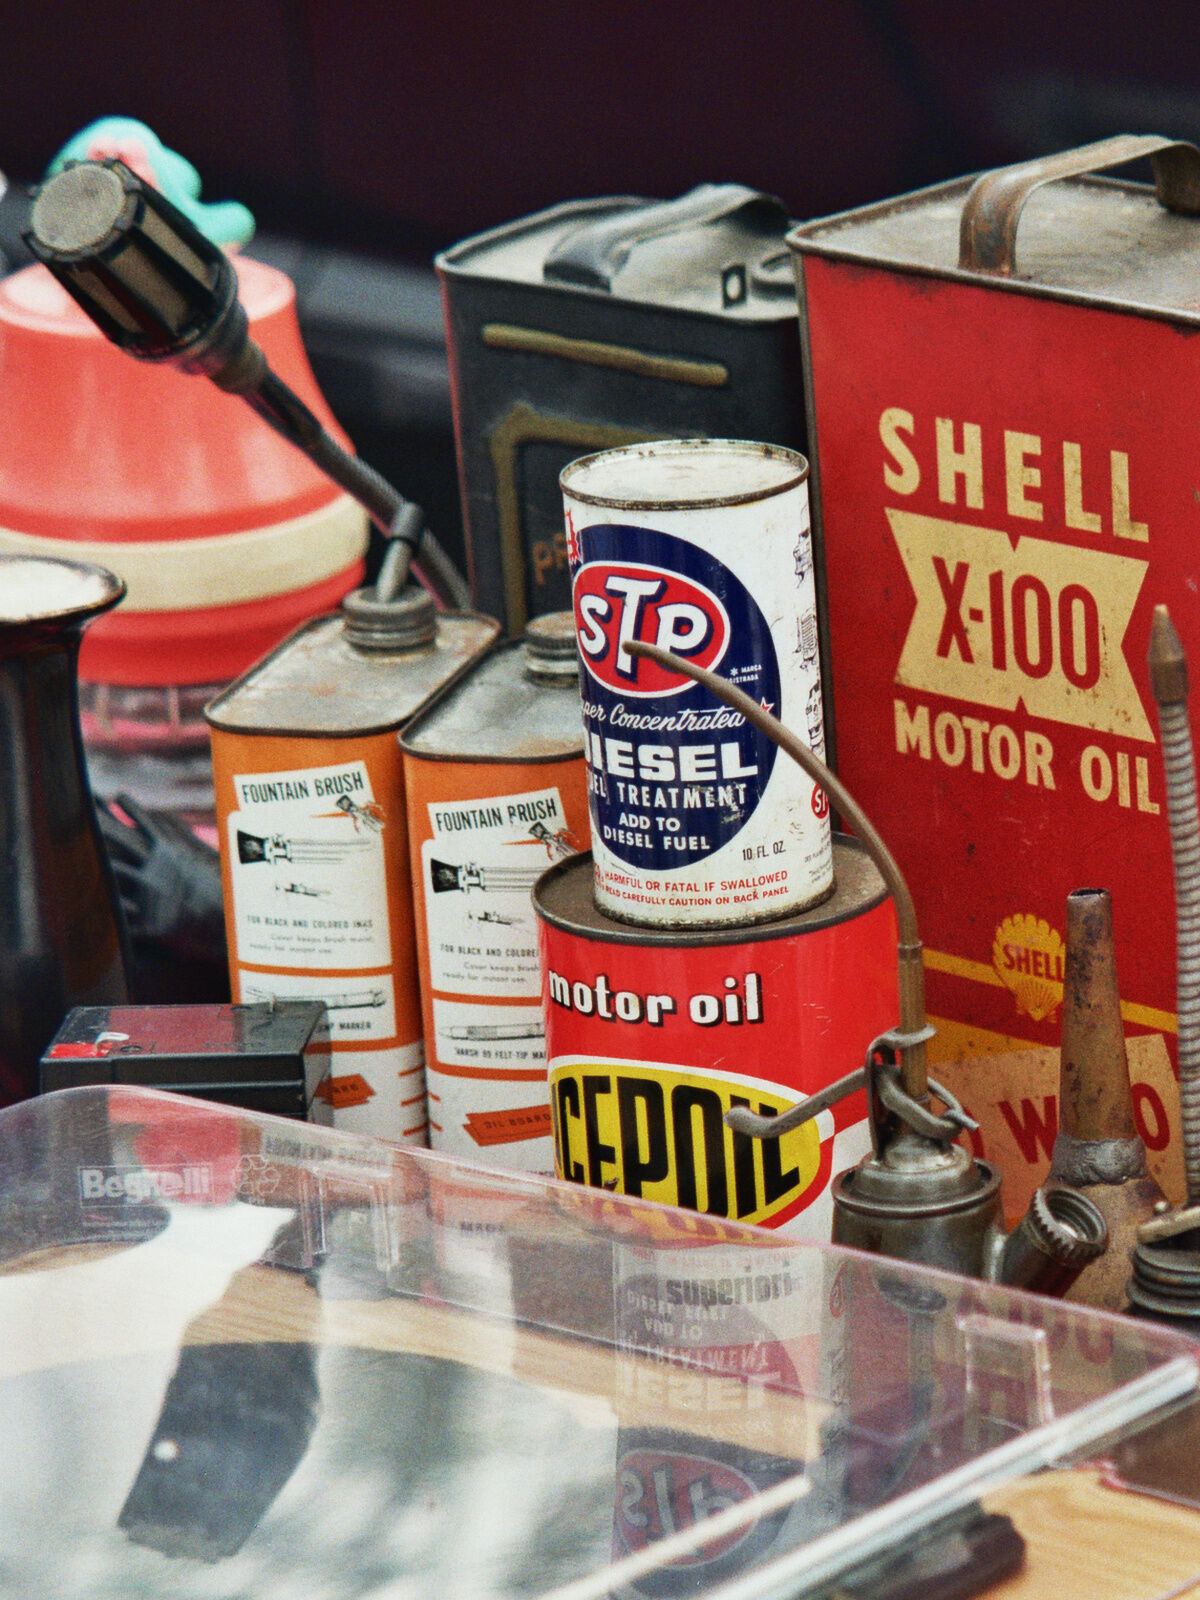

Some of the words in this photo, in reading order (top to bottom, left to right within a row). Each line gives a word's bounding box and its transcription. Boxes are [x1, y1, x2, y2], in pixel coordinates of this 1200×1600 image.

[878, 406, 1150, 544] SHELL
[578, 576, 709, 675] STP
[931, 554, 1101, 691] X-100
[894, 699, 1057, 791] MOTOR
[1079, 744, 1161, 815] OIL
[241, 780, 310, 804] FOUNTAIN
[314, 771, 364, 797] BRUSH
[617, 779, 749, 809] TREATMENT
[435, 806, 504, 832] FOUNTAIN
[619, 812, 651, 831] ADD
[655, 816, 681, 832] TO
[603, 825, 654, 850] DIESEL
[663, 829, 711, 851] FUEL
[742, 845, 753, 862] 10
[604, 869, 644, 892] HARMFUL
[646, 877, 663, 892] OR
[665, 877, 701, 893] FATAL
[703, 876, 716, 892] IF
[719, 868, 789, 893] SWALLOWED
[622, 890, 667, 907] CAREFULLY
[668, 892, 713, 907] CAUTION
[715, 891, 731, 905] ON
[733, 888, 760, 903] BACK
[762, 884, 789, 900] PANEL
[457, 945, 482, 956] BLACK
[486, 947, 502, 958] AND
[1002, 943, 1065, 983] SHELL
[547, 969, 677, 1028] motor
[689, 971, 764, 1027] oil
